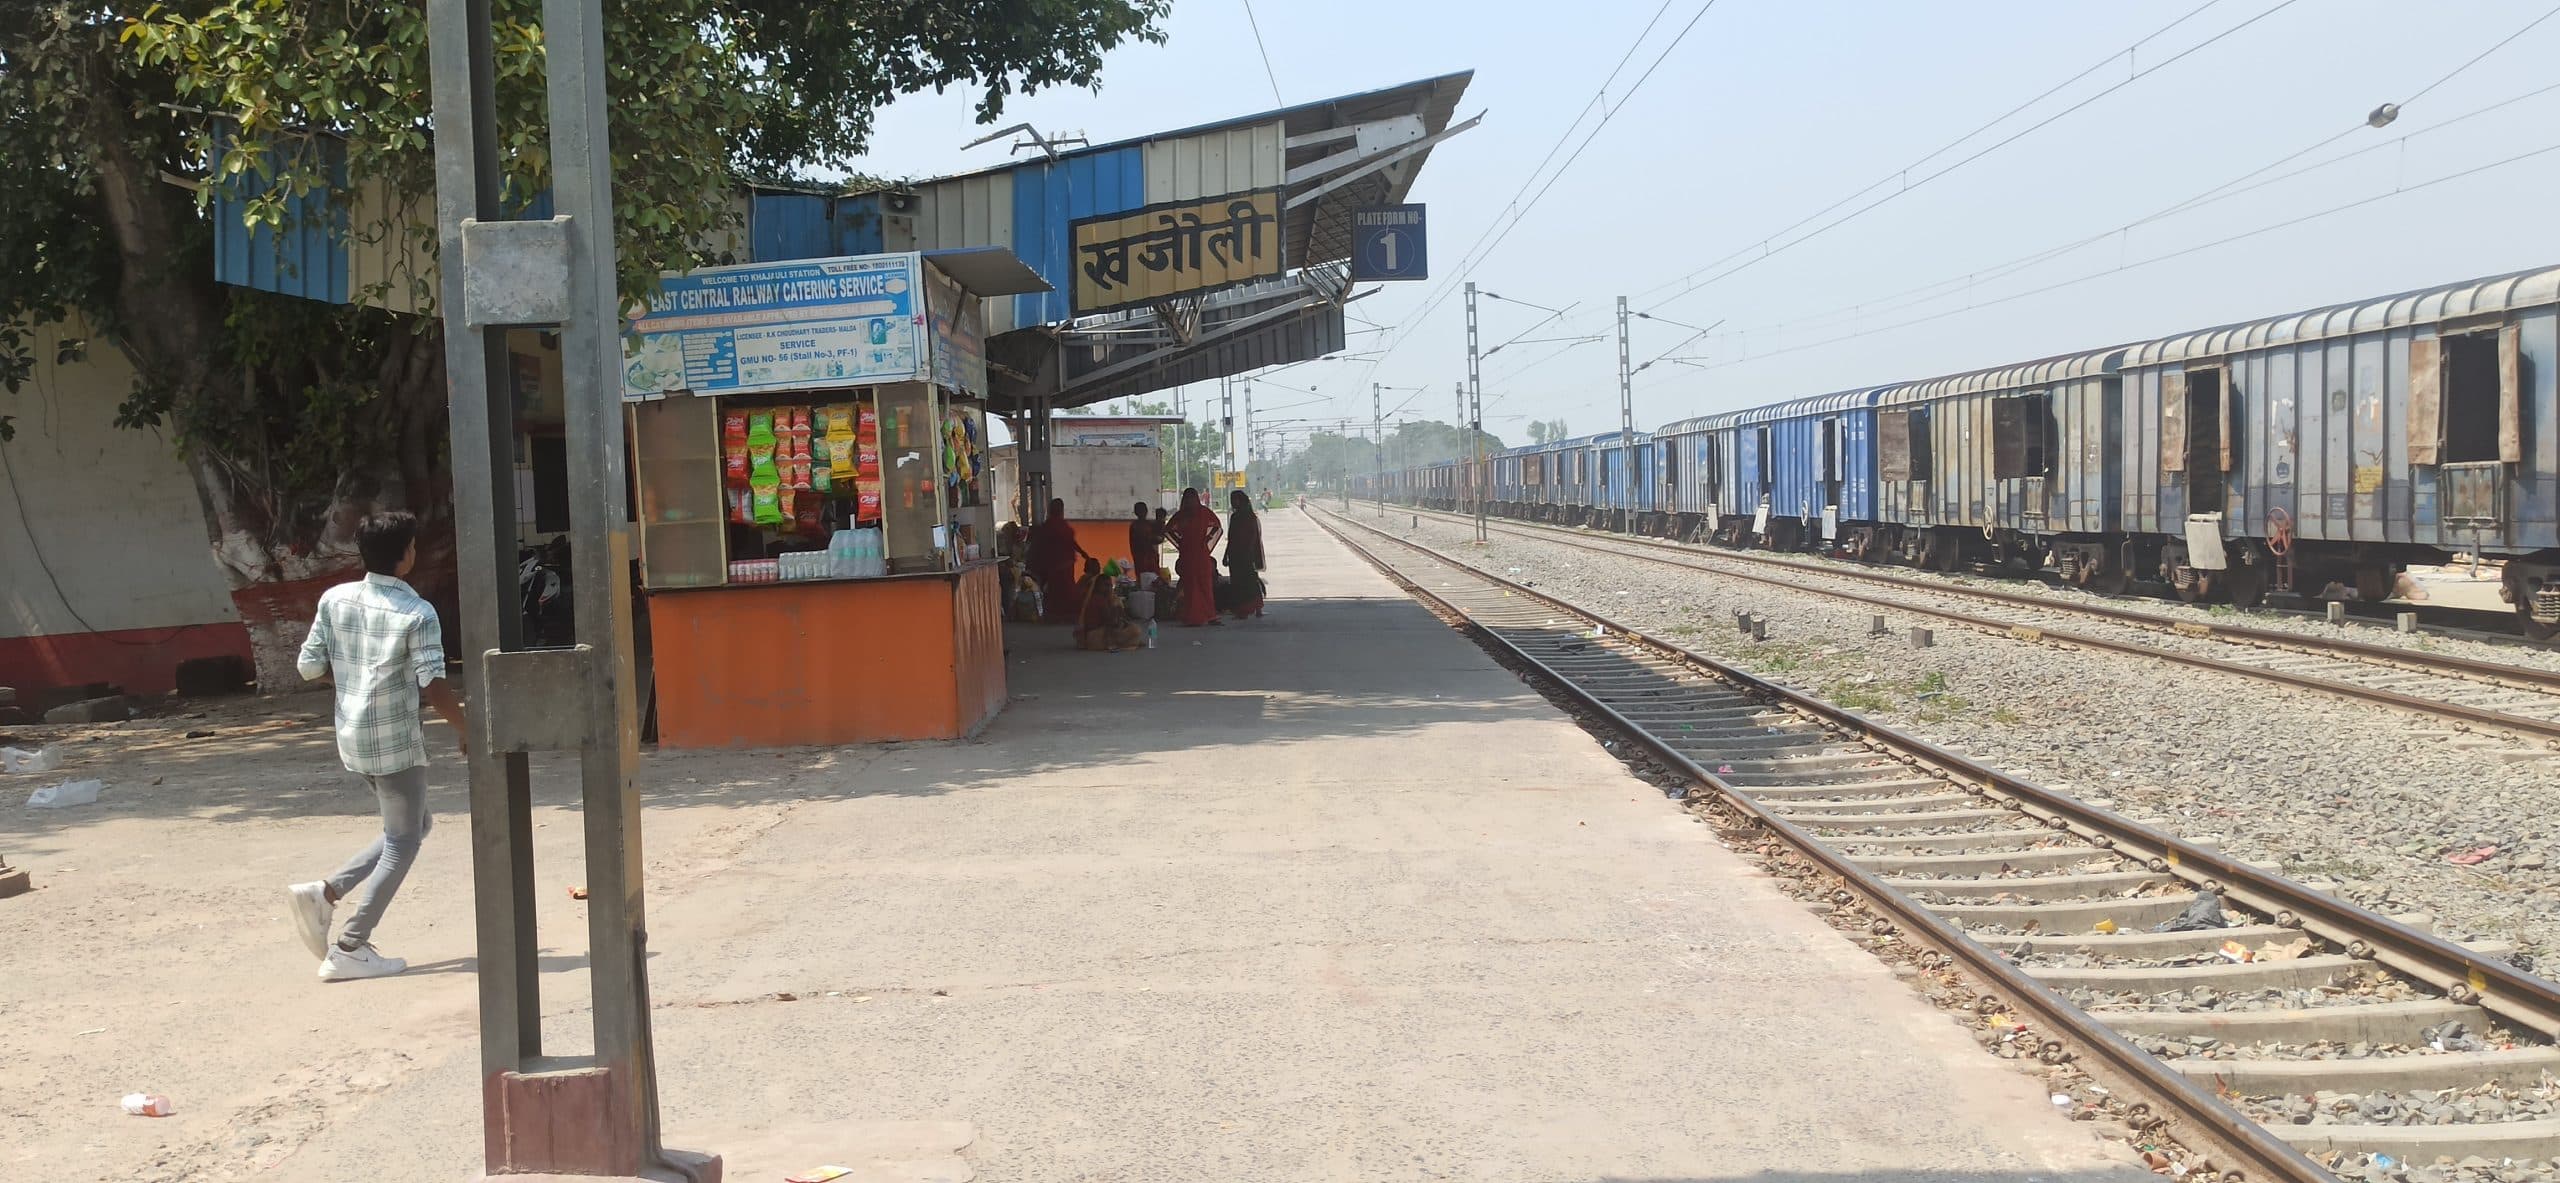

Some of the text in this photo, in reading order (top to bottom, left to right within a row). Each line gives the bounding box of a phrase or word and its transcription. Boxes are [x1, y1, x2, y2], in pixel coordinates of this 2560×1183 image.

[1380, 232, 1397, 270] 1
[702, 275, 738, 285] WELCOME
[740, 274, 750, 282] TO
[789, 268, 821, 278] STATION
[651, 274, 885, 313] EAST CENTRAL RAILWAY CATERING SERVICE
[736, 332, 762, 341] LICENSEE
[779, 339, 816, 350] SERVICE
[740, 355, 760, 365] GMU
[779, 352, 789, 362] 56
[790, 350, 812, 362] (Stall
[837, 347, 858, 359] PF-1)
